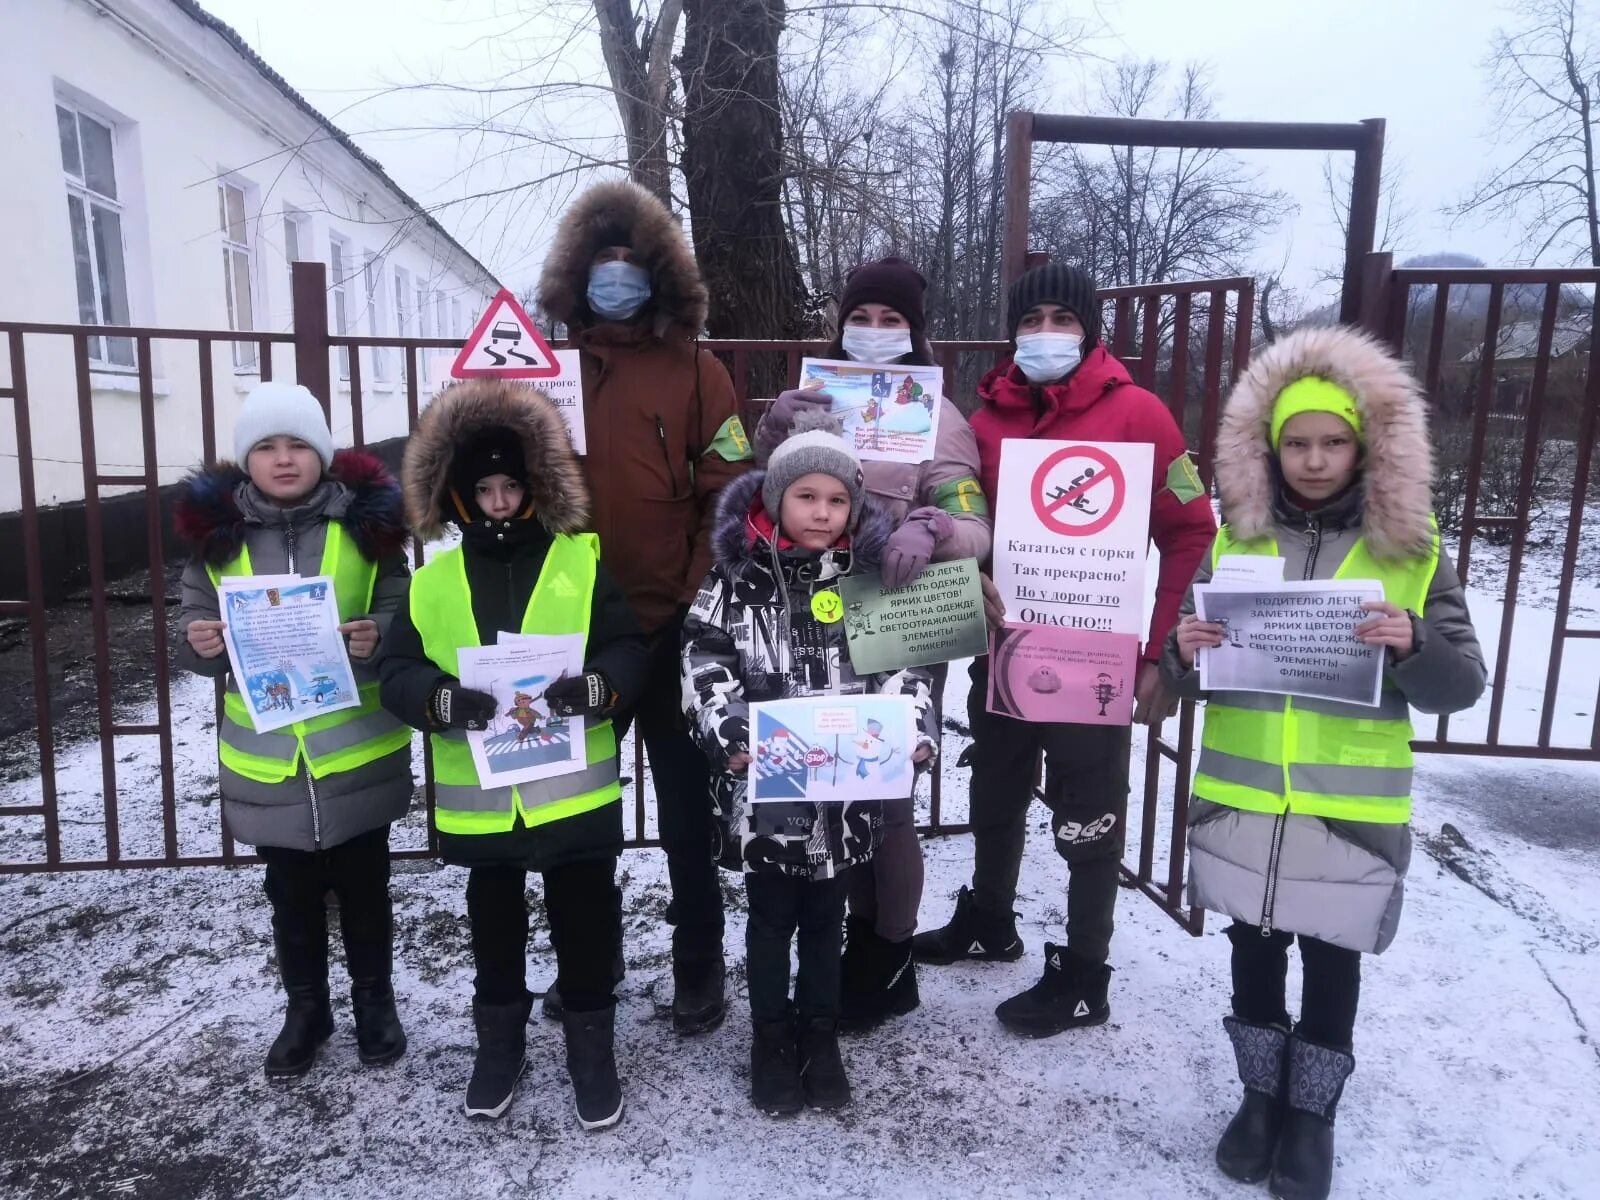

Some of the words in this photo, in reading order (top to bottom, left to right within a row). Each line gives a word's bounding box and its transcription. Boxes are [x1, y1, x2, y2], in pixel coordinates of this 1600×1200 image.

[539, 380, 577, 391] строго:
[1008, 540, 1075, 557] Кататься
[1080, 548, 1087, 556] с
[1091, 548, 1135, 561] горки
[937, 565, 965, 577] ЛЕГЧЕ
[1012, 563, 1040, 577] Так
[1044, 568, 1127, 583] прекрасно!
[879, 584, 929, 597] ЗАМЕТИТЬ
[930, 576, 970, 590] ОДЕЖДУ
[890, 596, 922, 608] ЯРКИХ
[924, 590, 962, 604] ЦВЕТОВ!
[1016, 586, 1036, 599] Но
[1040, 591, 1047, 602] у
[1052, 592, 1093, 605] дорог
[1097, 595, 1120, 605] это
[1255, 596, 1324, 607] ВОДИТЕЛЮ
[1327, 596, 1363, 606] ЛЕГЧЕ
[880, 609, 919, 621] НОСИТЬ
[921, 606, 934, 615] НА
[936, 600, 976, 613] ОДЕЖДЕ
[1250, 610, 1313, 619] ЗАМЕТИТЬ
[1316, 609, 1370, 620] ОДЕЖДУ
[879, 611, 979, 633] СВЕТООТРАЖАЮЩИЕ
[1020, 608, 1113, 630] ОПАСНО!!!
[1264, 621, 1302, 630] ЯРКИХ
[902, 629, 954, 642] ЭЛЕМЕНТЫ
[1250, 633, 1297, 643] НОСИТЬ
[1300, 634, 1315, 643] НА
[1249, 642, 1373, 659] СВЕТООТРАЖАЮЩИЕ
[1274, 655, 1338, 668] ЭЛЕМЕНТЫ
[1280, 668, 1340, 682] ФЛИКЕРЫ!
[806, 753, 827, 764] STOP
